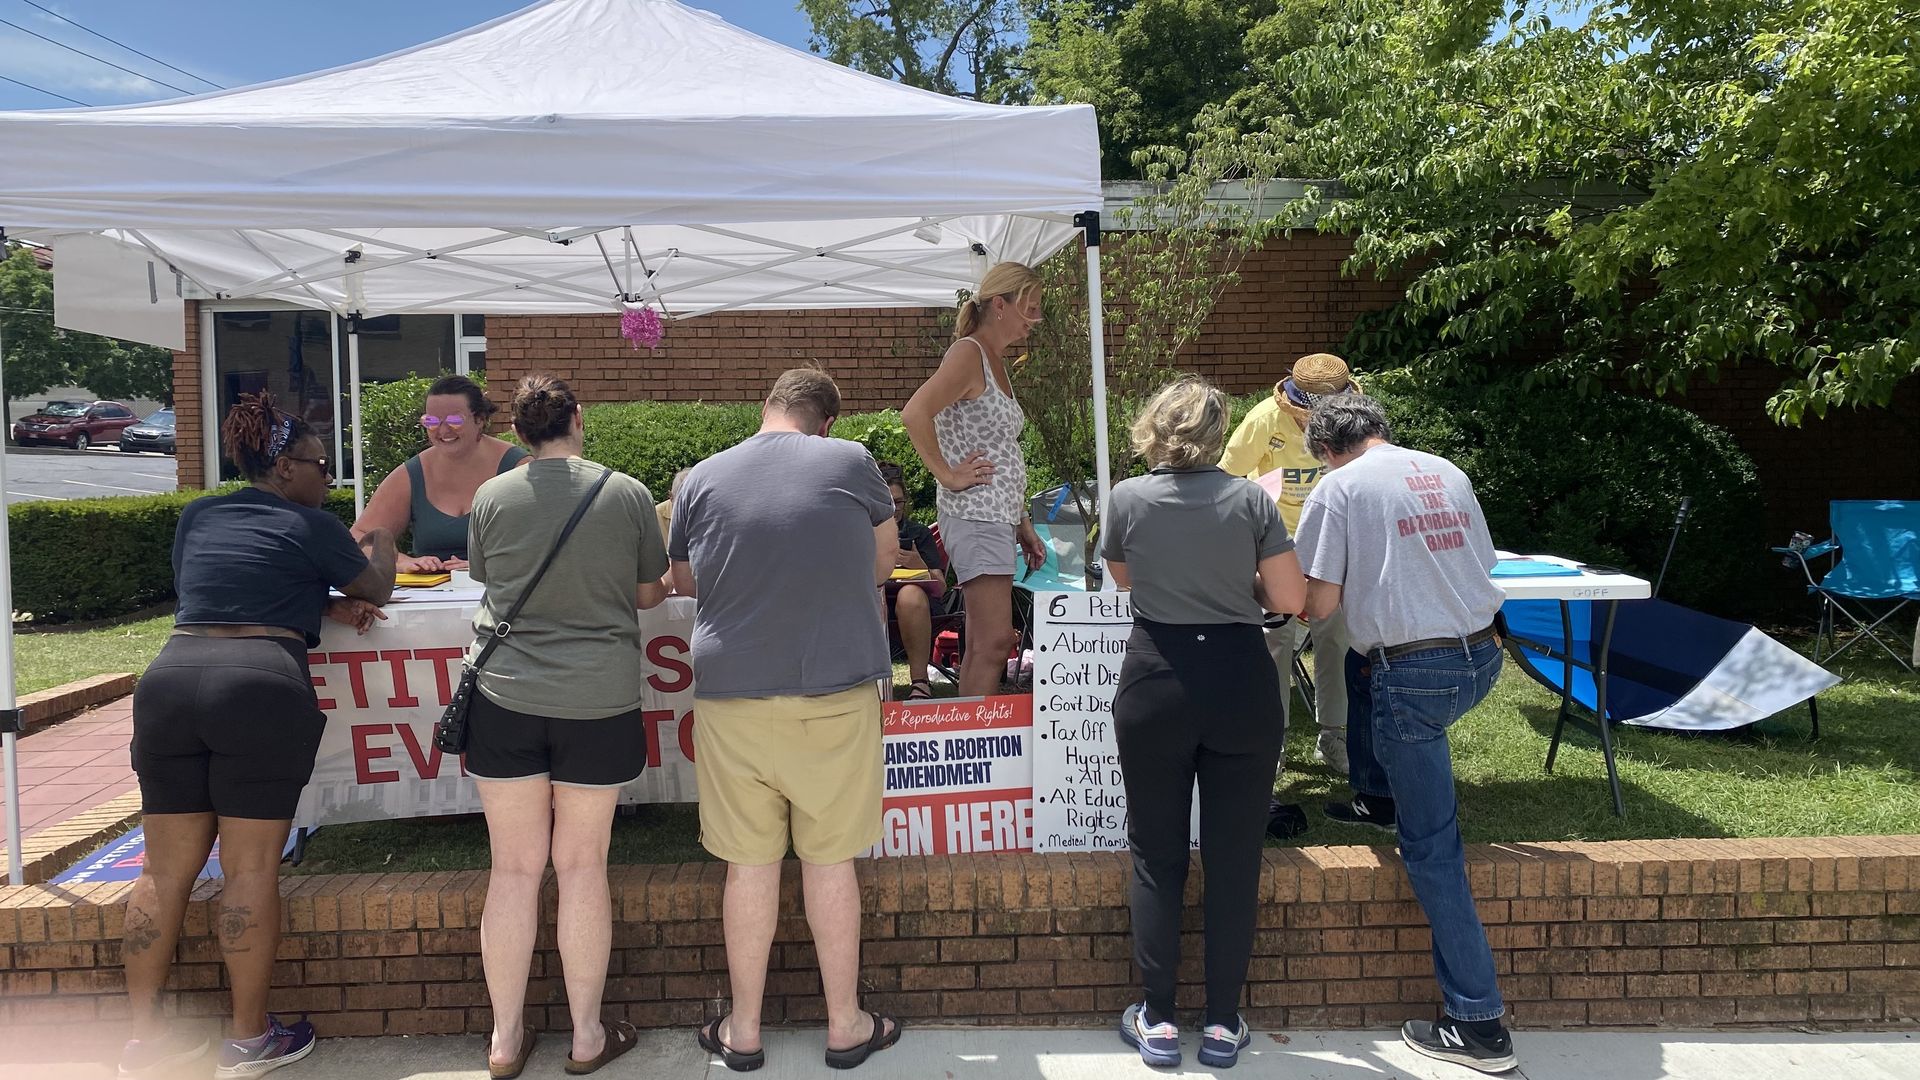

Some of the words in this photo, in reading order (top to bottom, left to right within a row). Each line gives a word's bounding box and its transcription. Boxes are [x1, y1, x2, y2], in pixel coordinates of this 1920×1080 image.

[1405, 474, 1445, 491] BACK
[1419, 493, 1449, 510] THE
[1398, 511, 1471, 537] RAZORBACK
[1425, 531, 1464, 552] BAND
[1573, 588, 1609, 597] GOFF
[1049, 595, 1069, 618] 6
[1089, 595, 1131, 618] Peti
[1052, 632, 1128, 654] Abortion
[1050, 662, 1091, 686] Gov't
[1097, 663, 1121, 686] Dis
[1086, 694, 1112, 713] Dis
[900, 704, 971, 730] Reproductive
[976, 701, 1014, 727] Rights!
[1049, 719, 1079, 741] Tax
[1081, 719, 1107, 743] Off
[883, 740, 940, 766] ANSAS
[945, 734, 1023, 762] ABORTION
[886, 761, 993, 791] AMENDMENT
[1079, 770, 1104, 786] All
[1111, 769, 1123, 787] D
[1050, 788, 1077, 806] AR
[1085, 788, 1126, 809] Educ
[944, 798, 1034, 855] HERE
[1066, 808, 1118, 835] Rights
[1048, 833, 1087, 848] Medical
[1438, 1025, 1465, 1047] N
